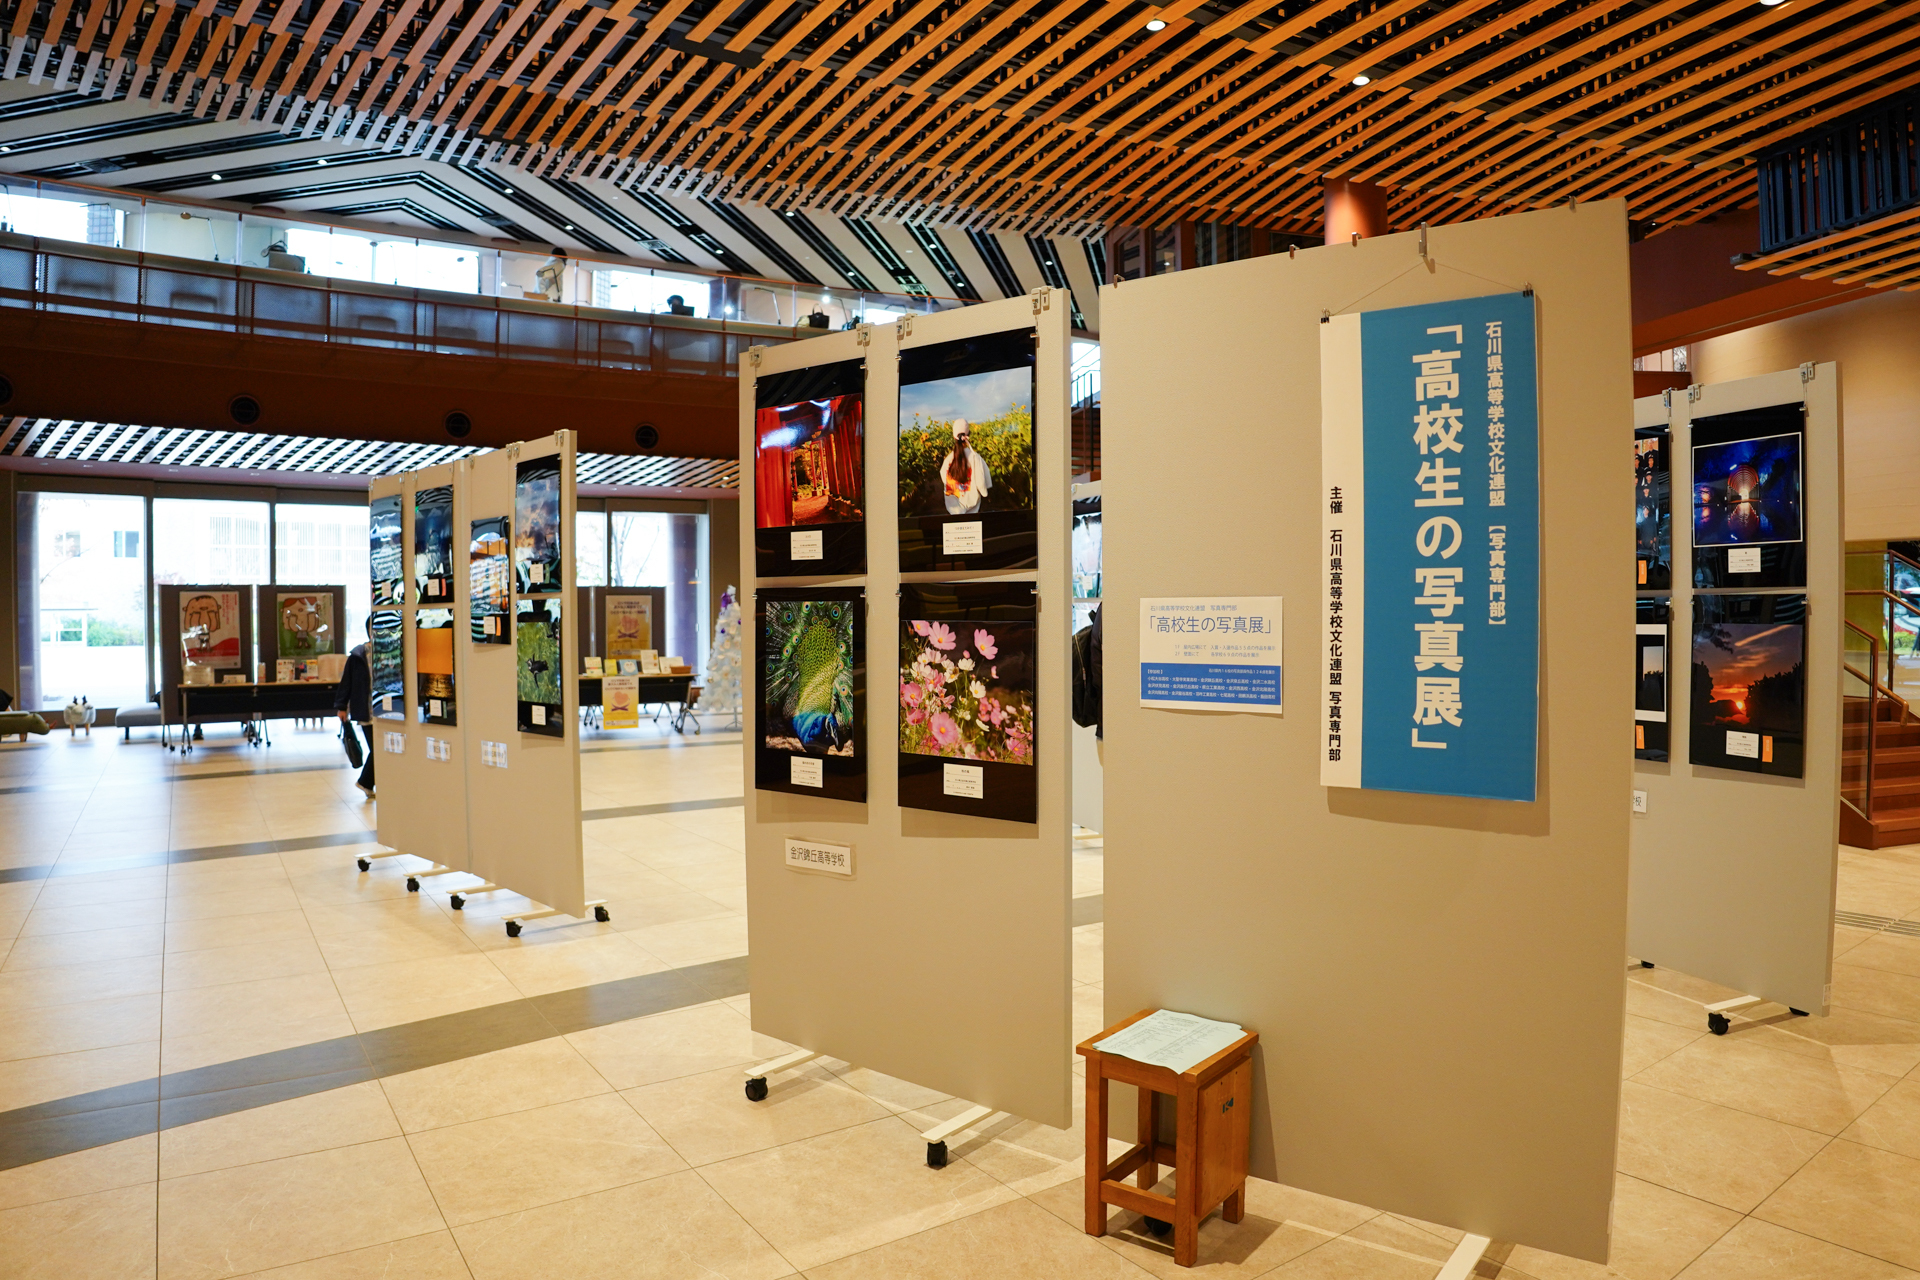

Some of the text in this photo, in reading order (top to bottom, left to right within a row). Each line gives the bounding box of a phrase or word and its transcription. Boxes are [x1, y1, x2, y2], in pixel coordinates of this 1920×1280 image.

[1210, 604, 1238, 612] 写真専門部
[1411, 324, 1464, 749] 「高校生の写真展」
[1486, 321, 1506, 625] 石川県高等学校文化連盟 【写真専門部】
[1149, 615, 1271, 634] 「高校生の写真展」
[1328, 486, 1343, 762] 主催 石川県高等学校文化連盟 写真専門部
